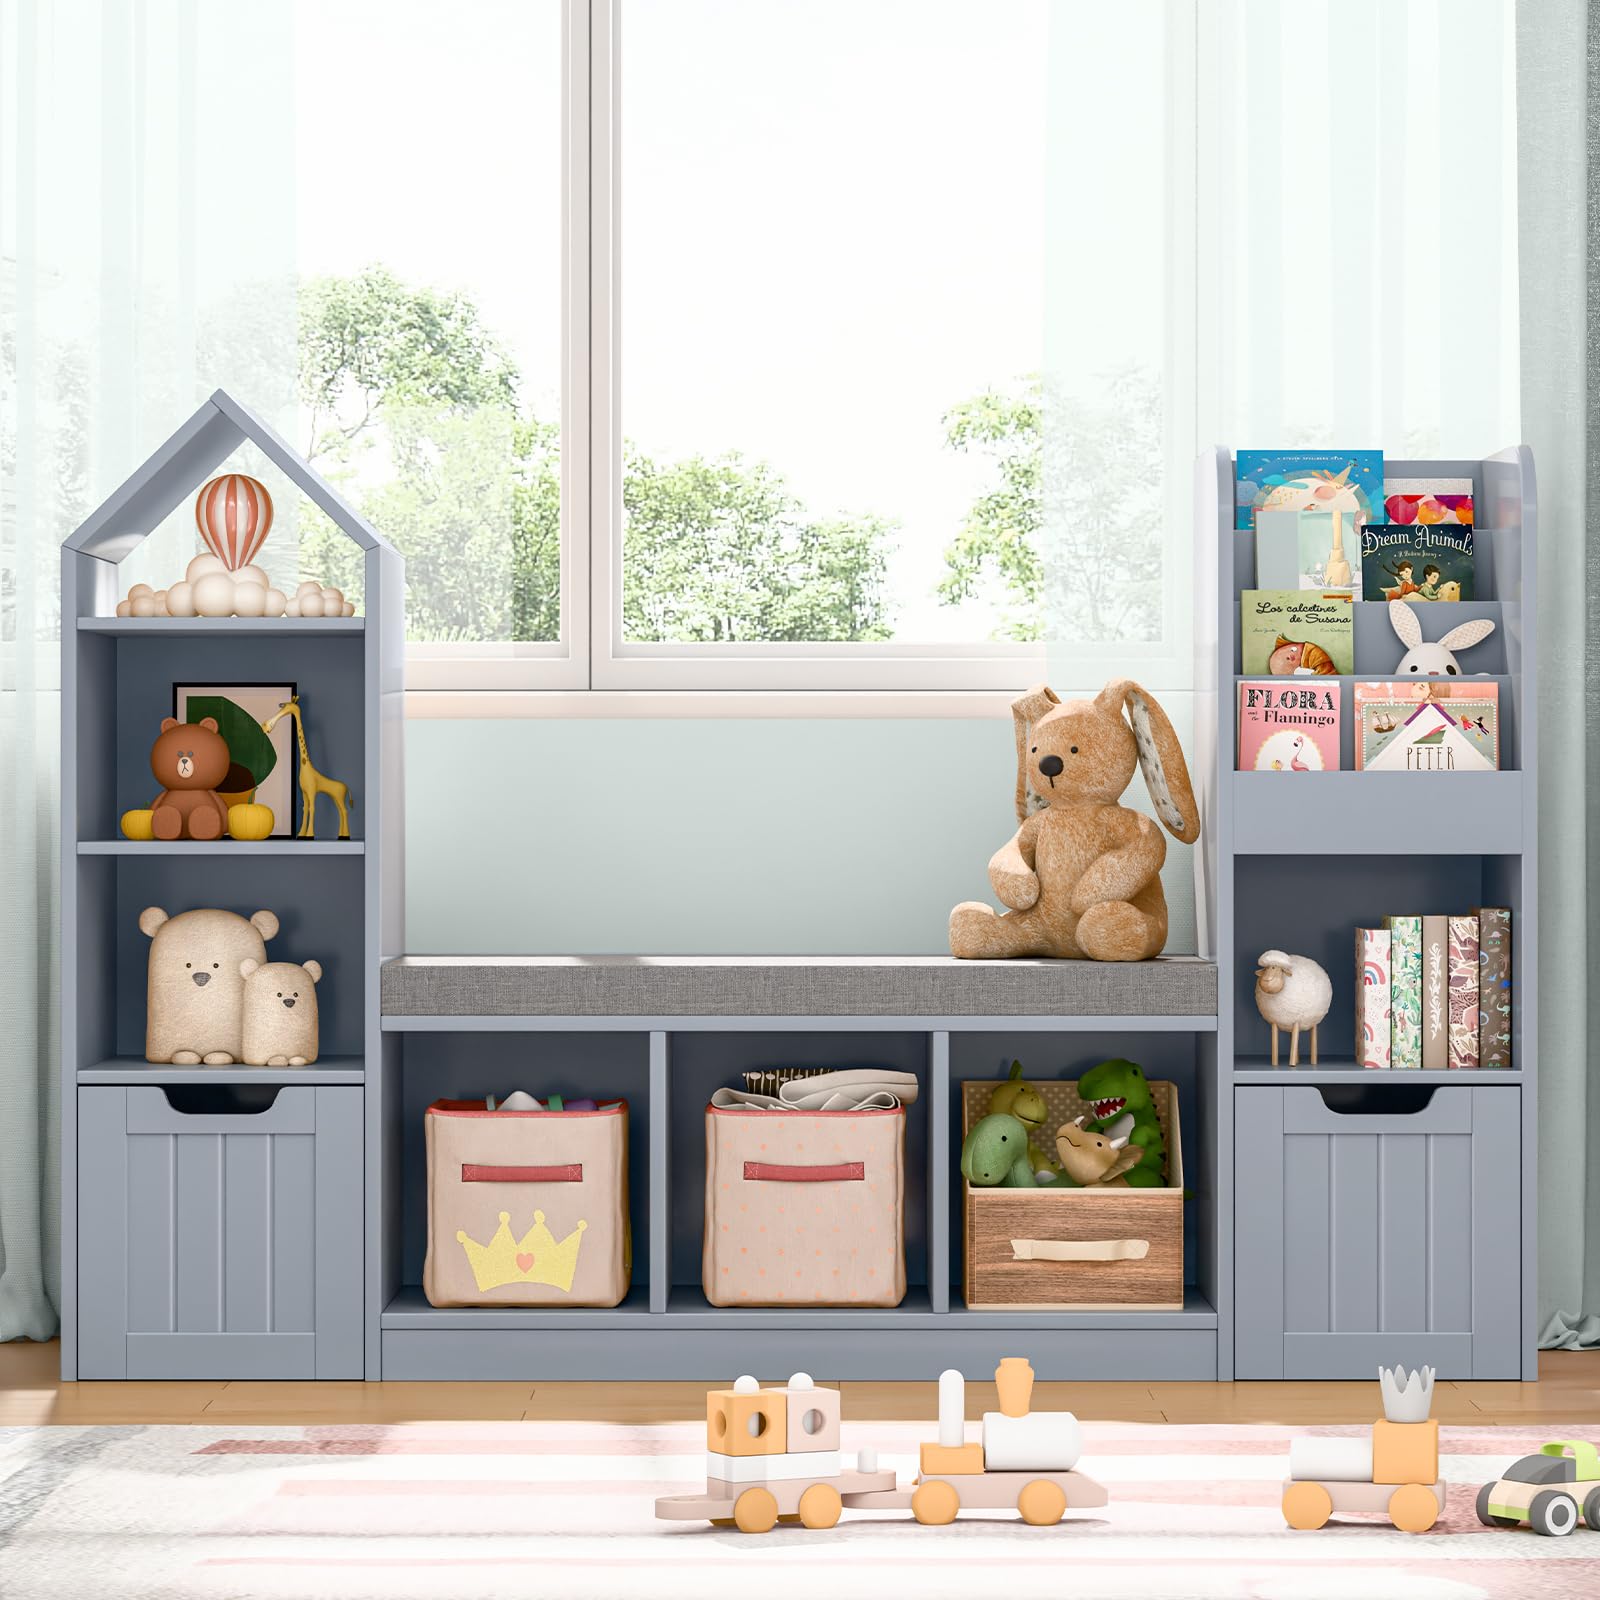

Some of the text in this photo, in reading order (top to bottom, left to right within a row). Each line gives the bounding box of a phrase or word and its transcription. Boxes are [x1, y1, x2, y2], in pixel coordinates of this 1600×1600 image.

[1361, 524, 1473, 557] Dream Animals
[1256, 602, 1337, 614] Los calcetines
[1289, 613, 1351, 624] de Susana
[1247, 690, 1336, 711] FLORA
[1264, 710, 1335, 728] Flamingo
[1407, 746, 1455, 770] PETER
